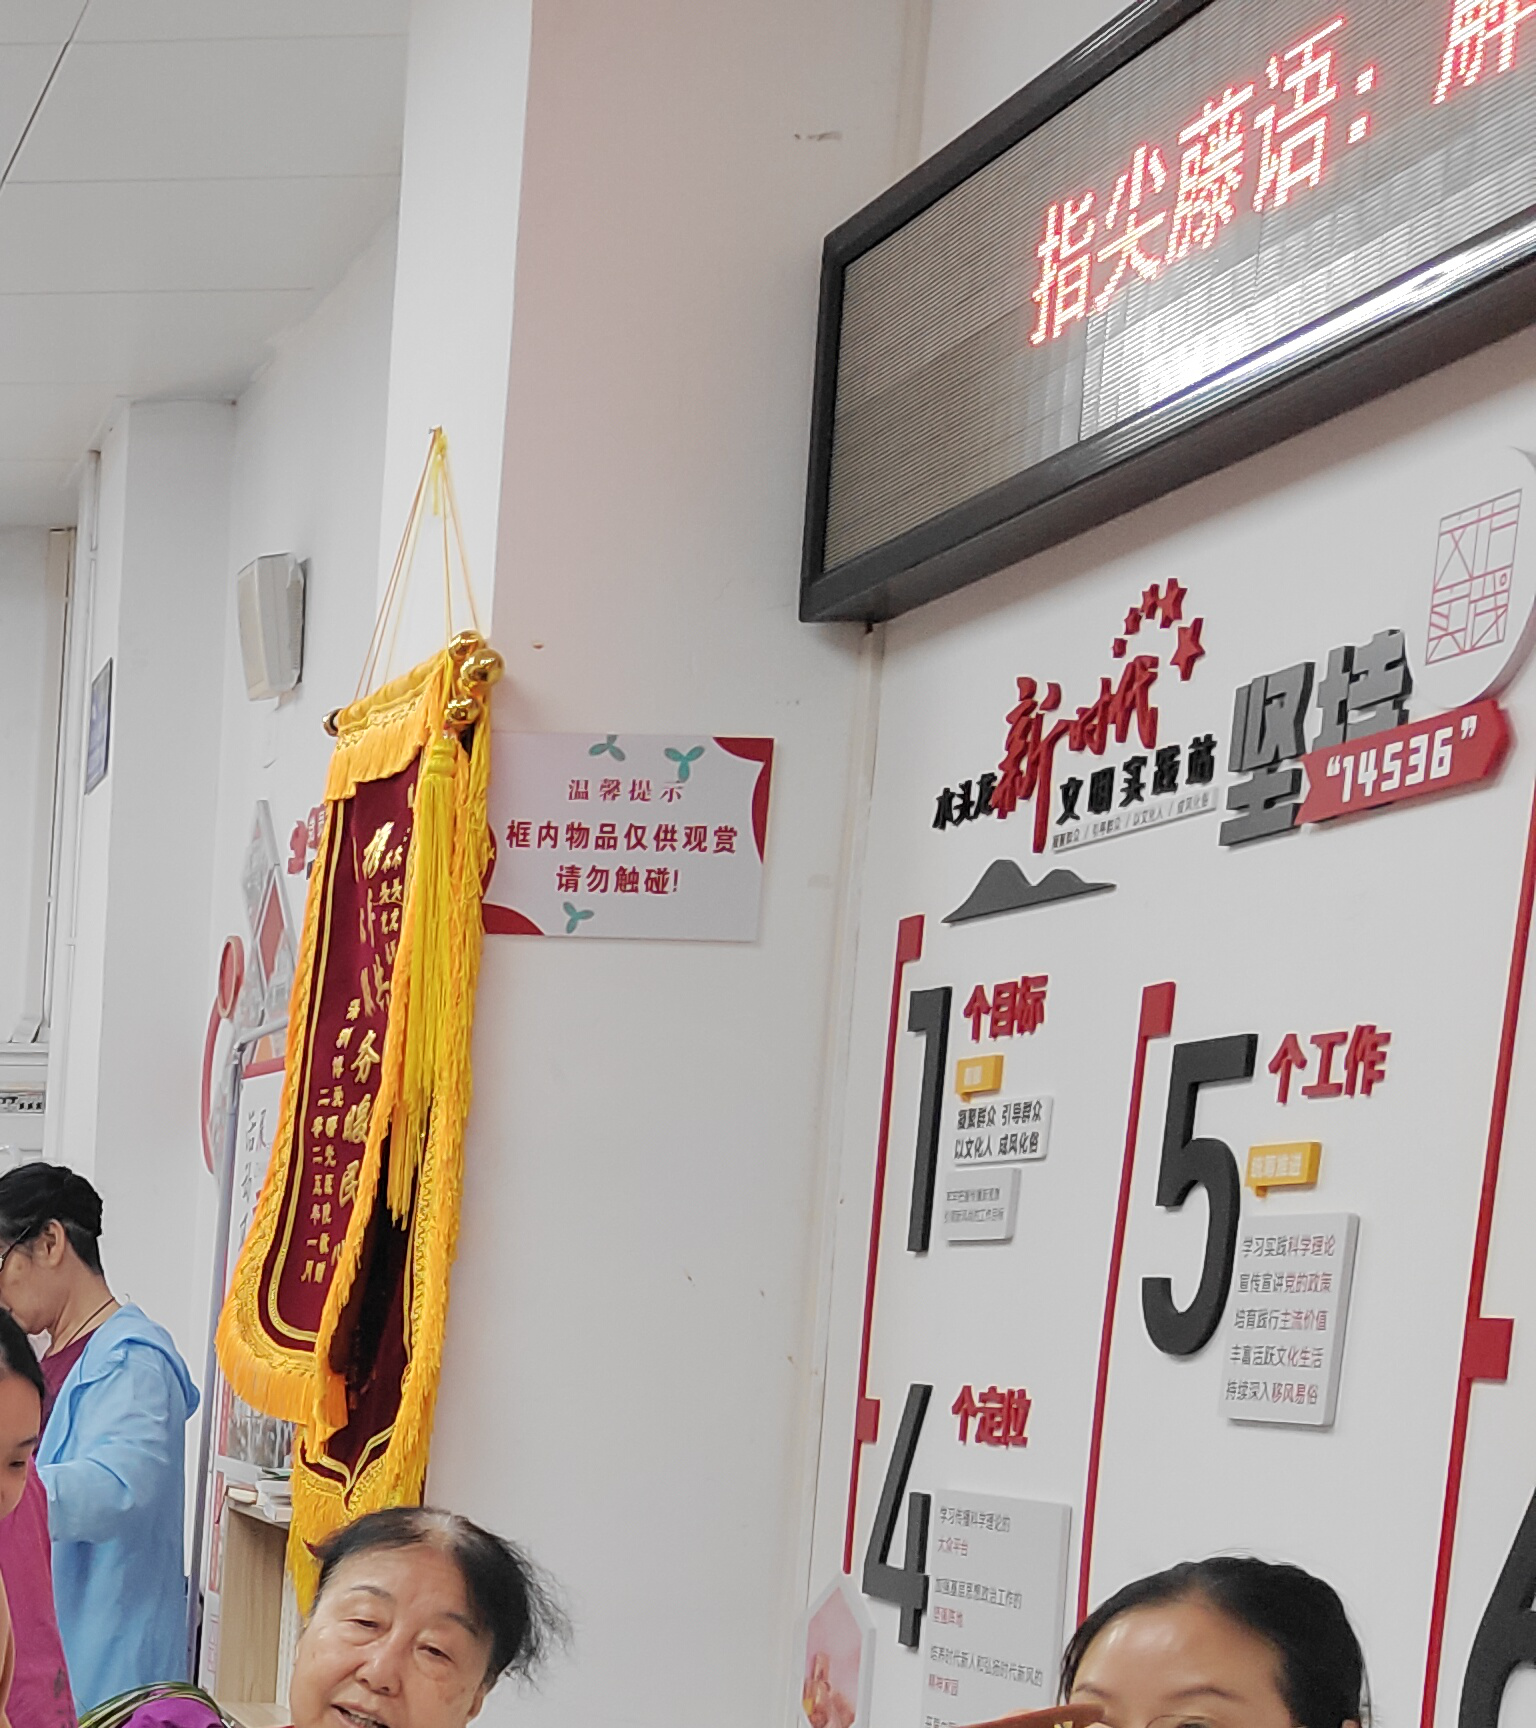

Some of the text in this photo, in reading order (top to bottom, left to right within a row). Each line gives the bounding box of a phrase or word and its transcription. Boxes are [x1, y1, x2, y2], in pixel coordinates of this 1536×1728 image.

[1220, 628, 1415, 847] 坚持
[568, 779, 684, 803] 温馨提示
[507, 819, 738, 854] 框内物品仅供观赏
[556, 864, 680, 896] 请勿触碰！
[963, 975, 1049, 1043] 个目标
[1268, 1025, 1391, 1103] 个工作
[907, 986, 952, 1252] 1
[954, 1136, 993, 1159] 以文化人
[1141, 1033, 1258, 1356] 5
[1242, 1235, 1336, 1257] 学习实践科学理论
[1238, 1272, 1332, 1294] 宣传宣讲党的政策
[1234, 1309, 1328, 1331] 培育践行主流价值
[1230, 1345, 1324, 1368] 丰富活跃文化生活
[1225, 1381, 1318, 1405] 持续深入移风易俗
[951, 1385, 1032, 1447] 个定位
[862, 1383, 933, 1647] 4
